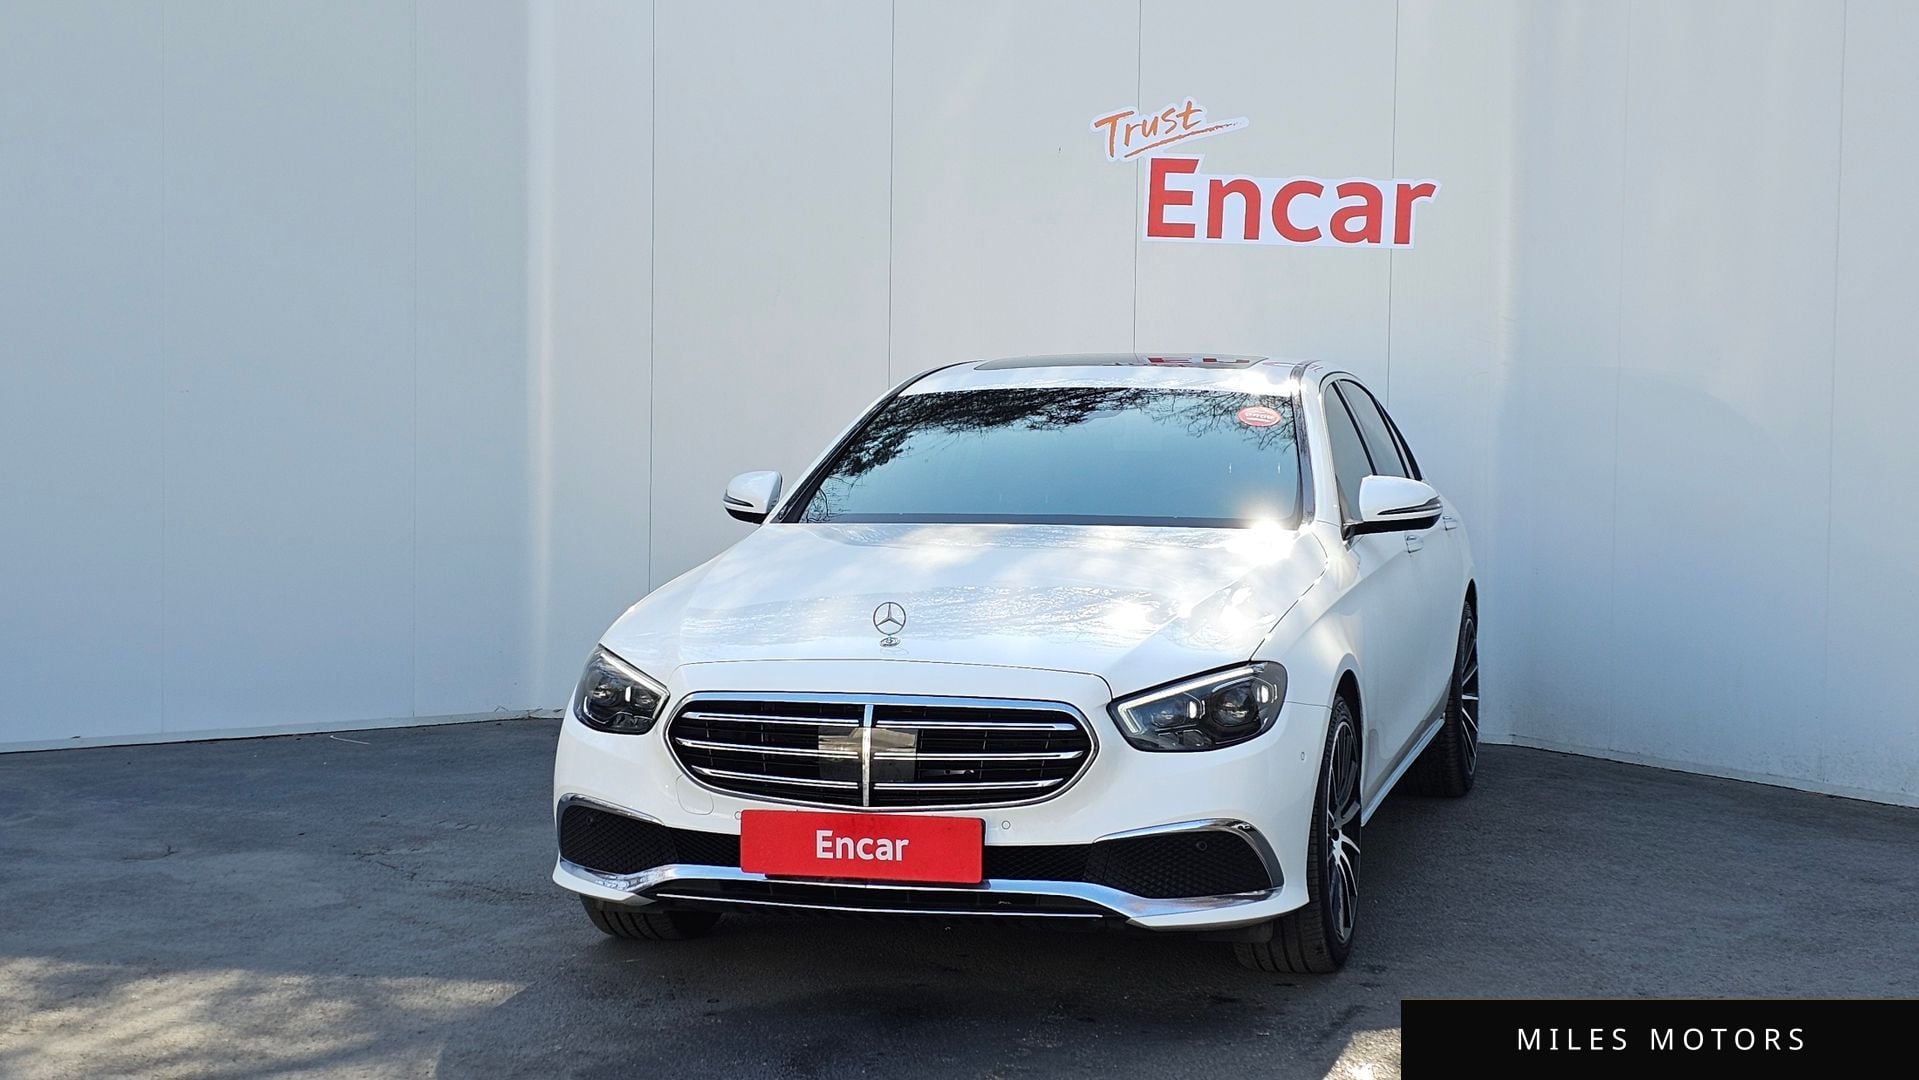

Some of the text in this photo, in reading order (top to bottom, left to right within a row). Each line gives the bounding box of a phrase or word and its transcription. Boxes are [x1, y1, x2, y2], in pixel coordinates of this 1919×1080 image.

[1094, 101, 1203, 157] Trust
[1147, 158, 1436, 244] Encar
[815, 829, 909, 861] Encar
